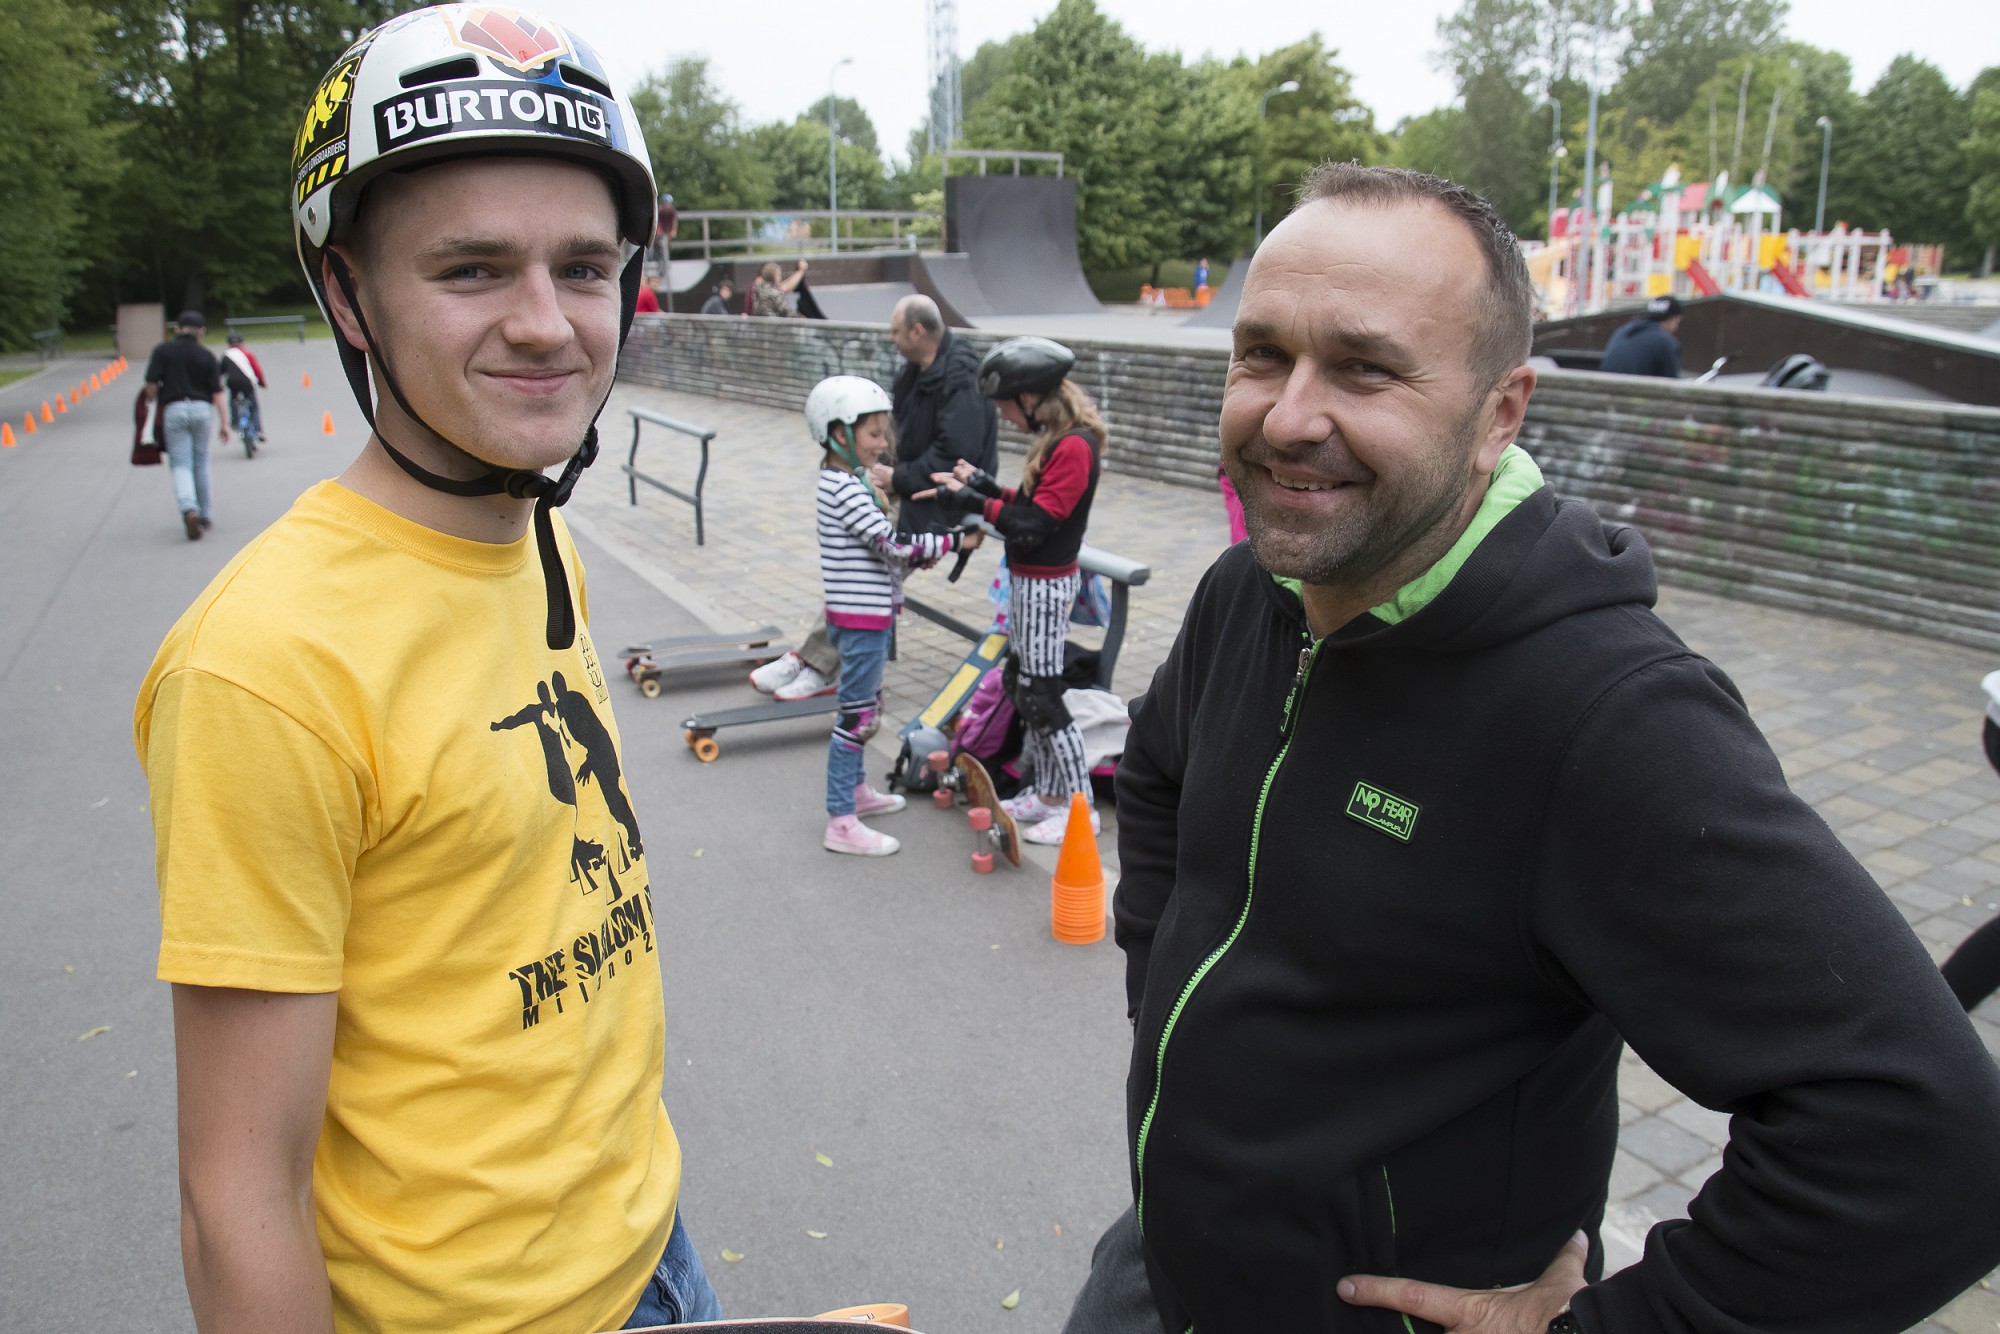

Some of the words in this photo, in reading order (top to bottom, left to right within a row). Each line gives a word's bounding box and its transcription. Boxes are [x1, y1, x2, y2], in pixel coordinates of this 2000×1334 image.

[384, 88, 577, 140] BURTON
[1356, 787, 1380, 809] NO
[1381, 798, 1413, 825] FEAR
[508, 948, 568, 1009] THE
